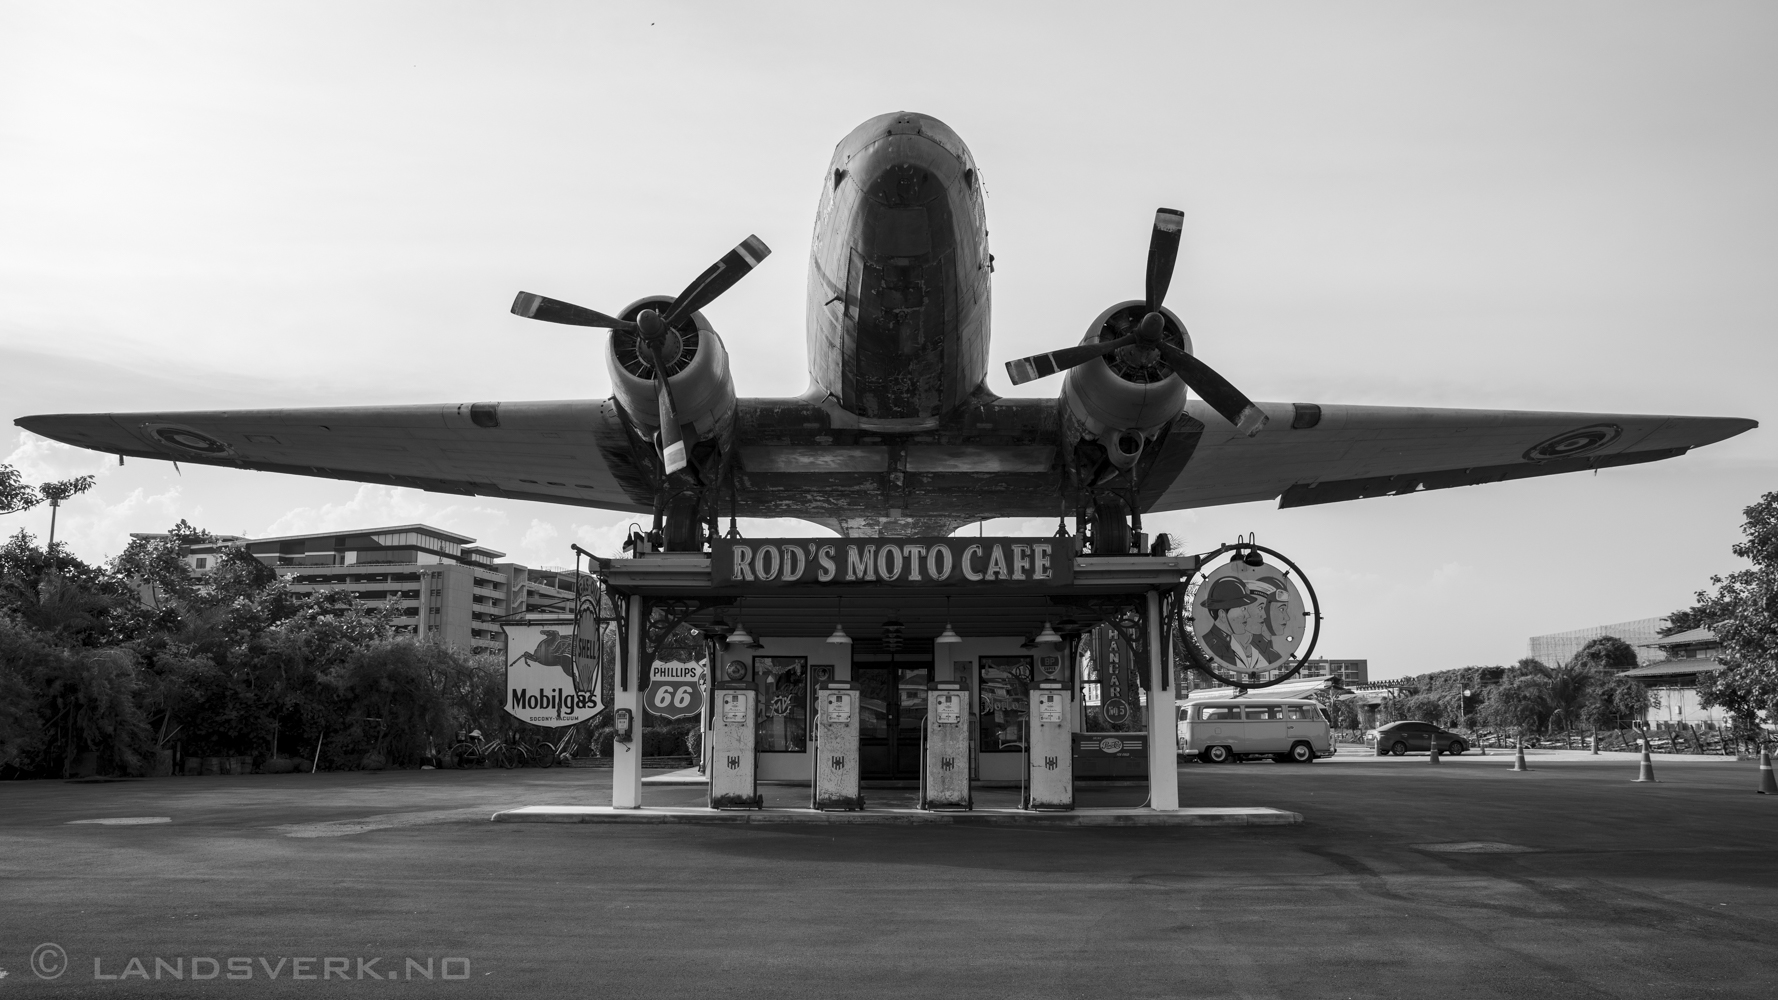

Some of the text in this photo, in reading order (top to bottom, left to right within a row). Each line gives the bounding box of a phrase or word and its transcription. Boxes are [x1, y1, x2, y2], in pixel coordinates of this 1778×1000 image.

[731, 542, 1053, 582] ROD'S MOTO CAFE
[578, 638, 597, 660] SHELL
[653, 667, 697, 678] PHILLIPS
[1044, 657, 1056, 666] BP
[1108, 629, 1121, 697] HANGAR
[511, 687, 598, 715] Mobilgas
[654, 685, 693, 708] 66
